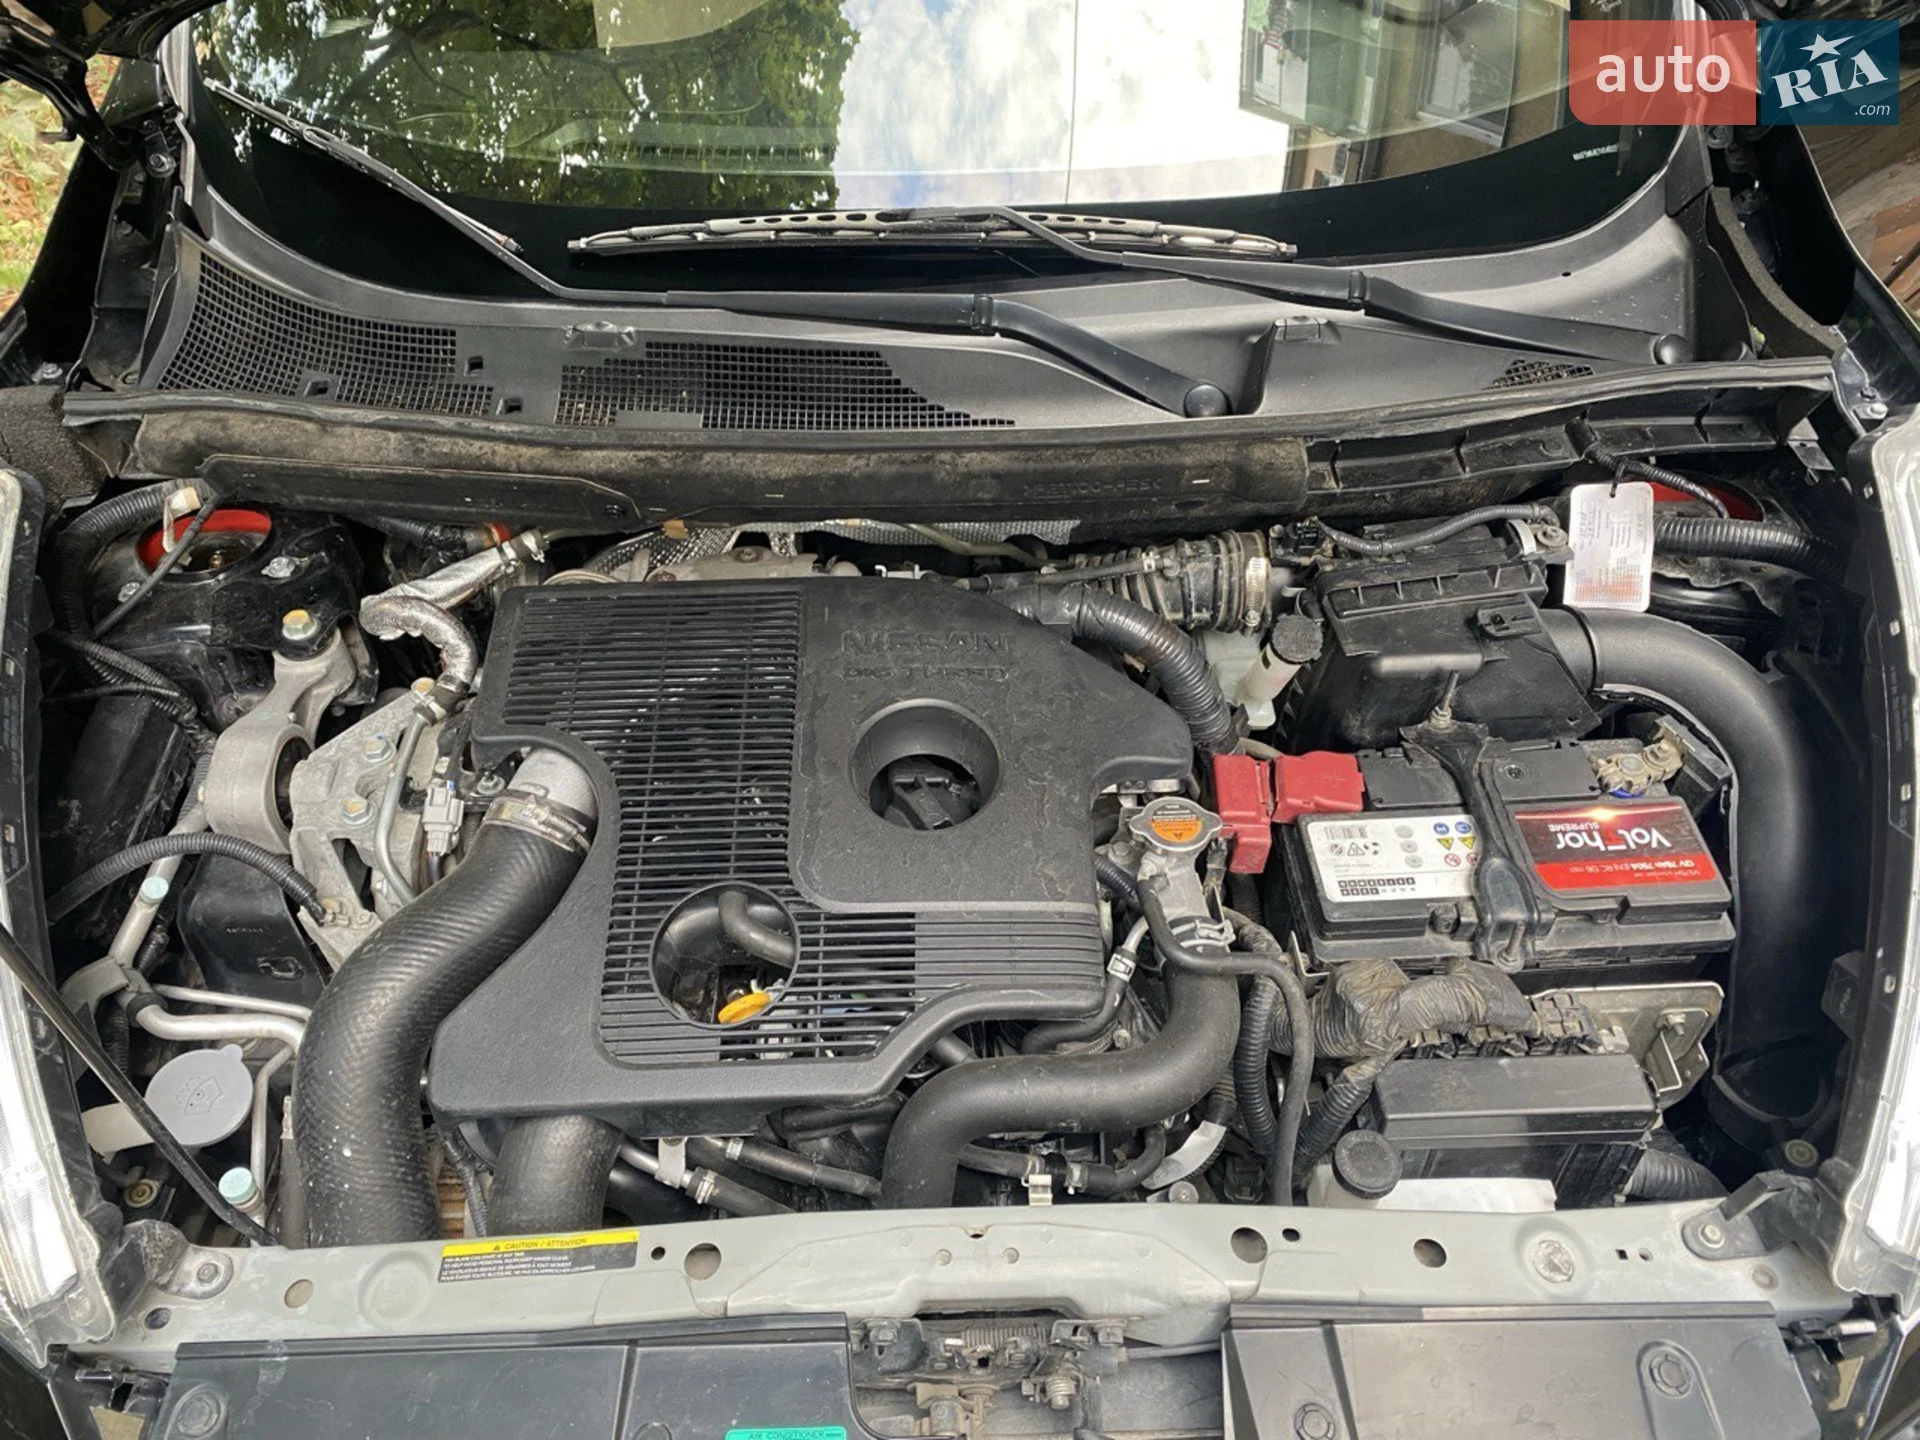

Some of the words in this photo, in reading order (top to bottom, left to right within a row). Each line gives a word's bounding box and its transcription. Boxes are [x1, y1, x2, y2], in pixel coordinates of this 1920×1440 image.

[840, 629, 1008, 654] NISSAN
[1547, 821, 1600, 832] SUPREME
[505, 1242, 538, 1250] CAUTION
[546, 1238, 588, 1248] ATTENTION
